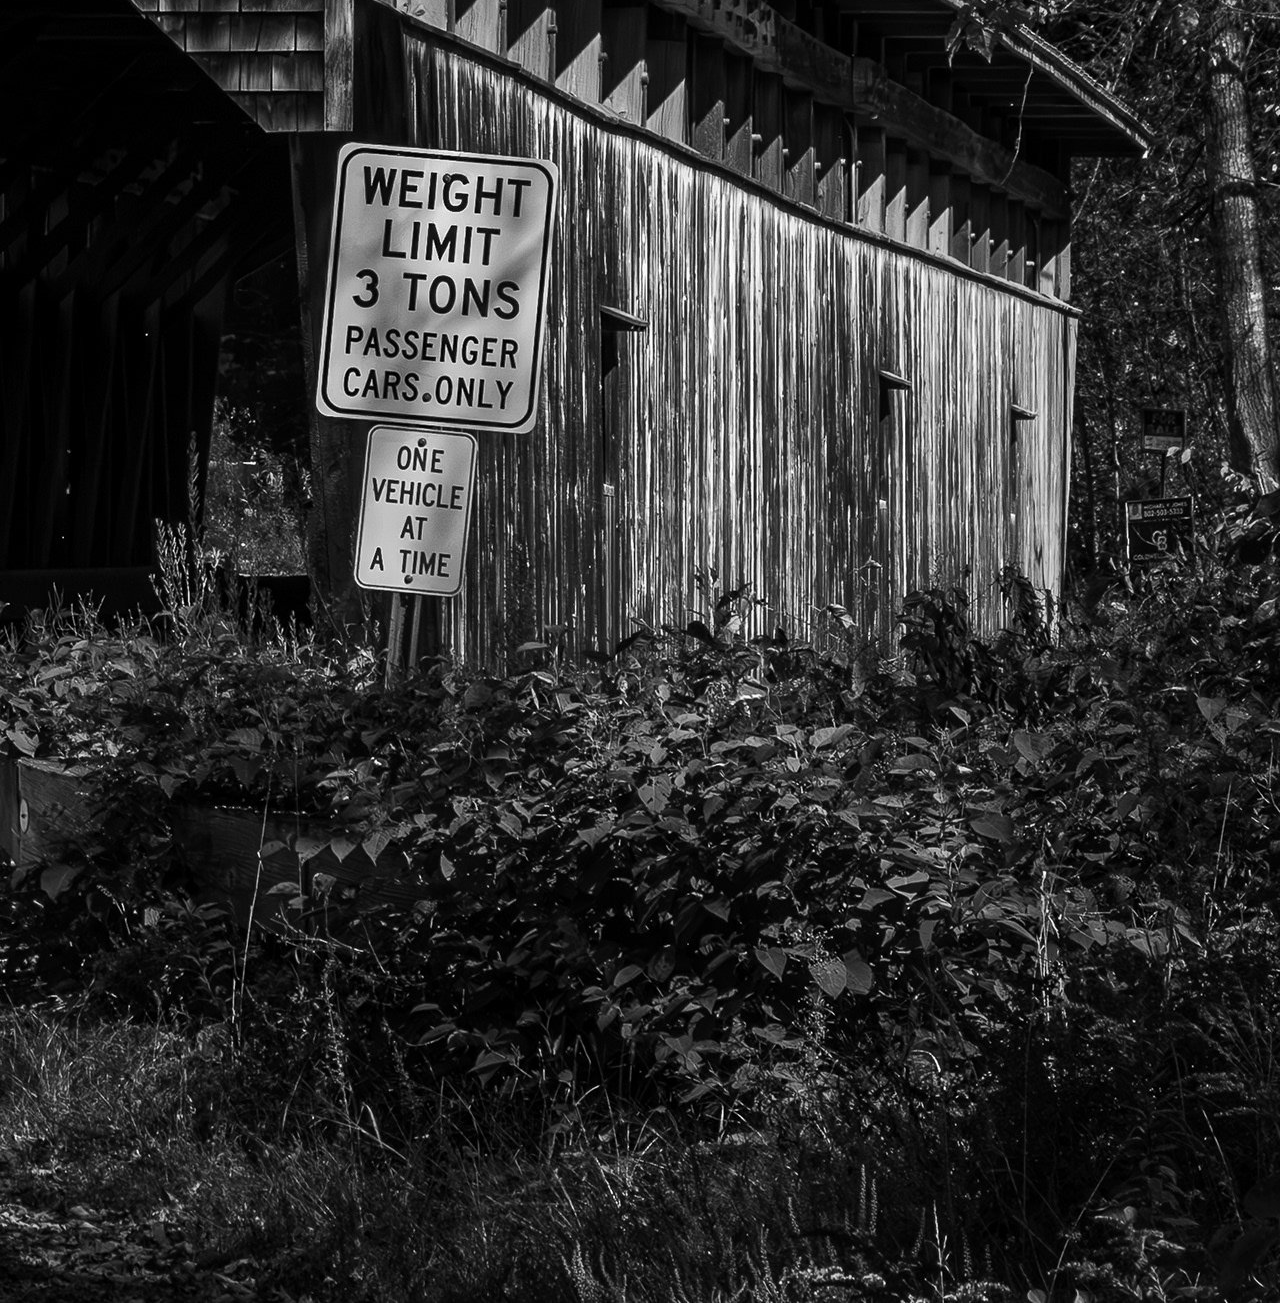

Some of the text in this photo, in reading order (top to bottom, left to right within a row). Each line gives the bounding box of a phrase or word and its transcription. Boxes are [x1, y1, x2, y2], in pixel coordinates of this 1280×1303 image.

[363, 165, 532, 218] WEIGHT
[382, 218, 501, 266] LIMIT
[352, 268, 520, 320] 3 TONS
[345, 325, 519, 369] PASSENGER
[343, 367, 514, 410] CARS ONLY
[1146, 424, 1181, 435] SALE
[1151, 412, 1176, 424] FOR
[397, 445, 444, 474] ONE
[372, 477, 464, 510] VEHICLE
[400, 515, 428, 541] AT
[370, 547, 451, 578] A TIME
